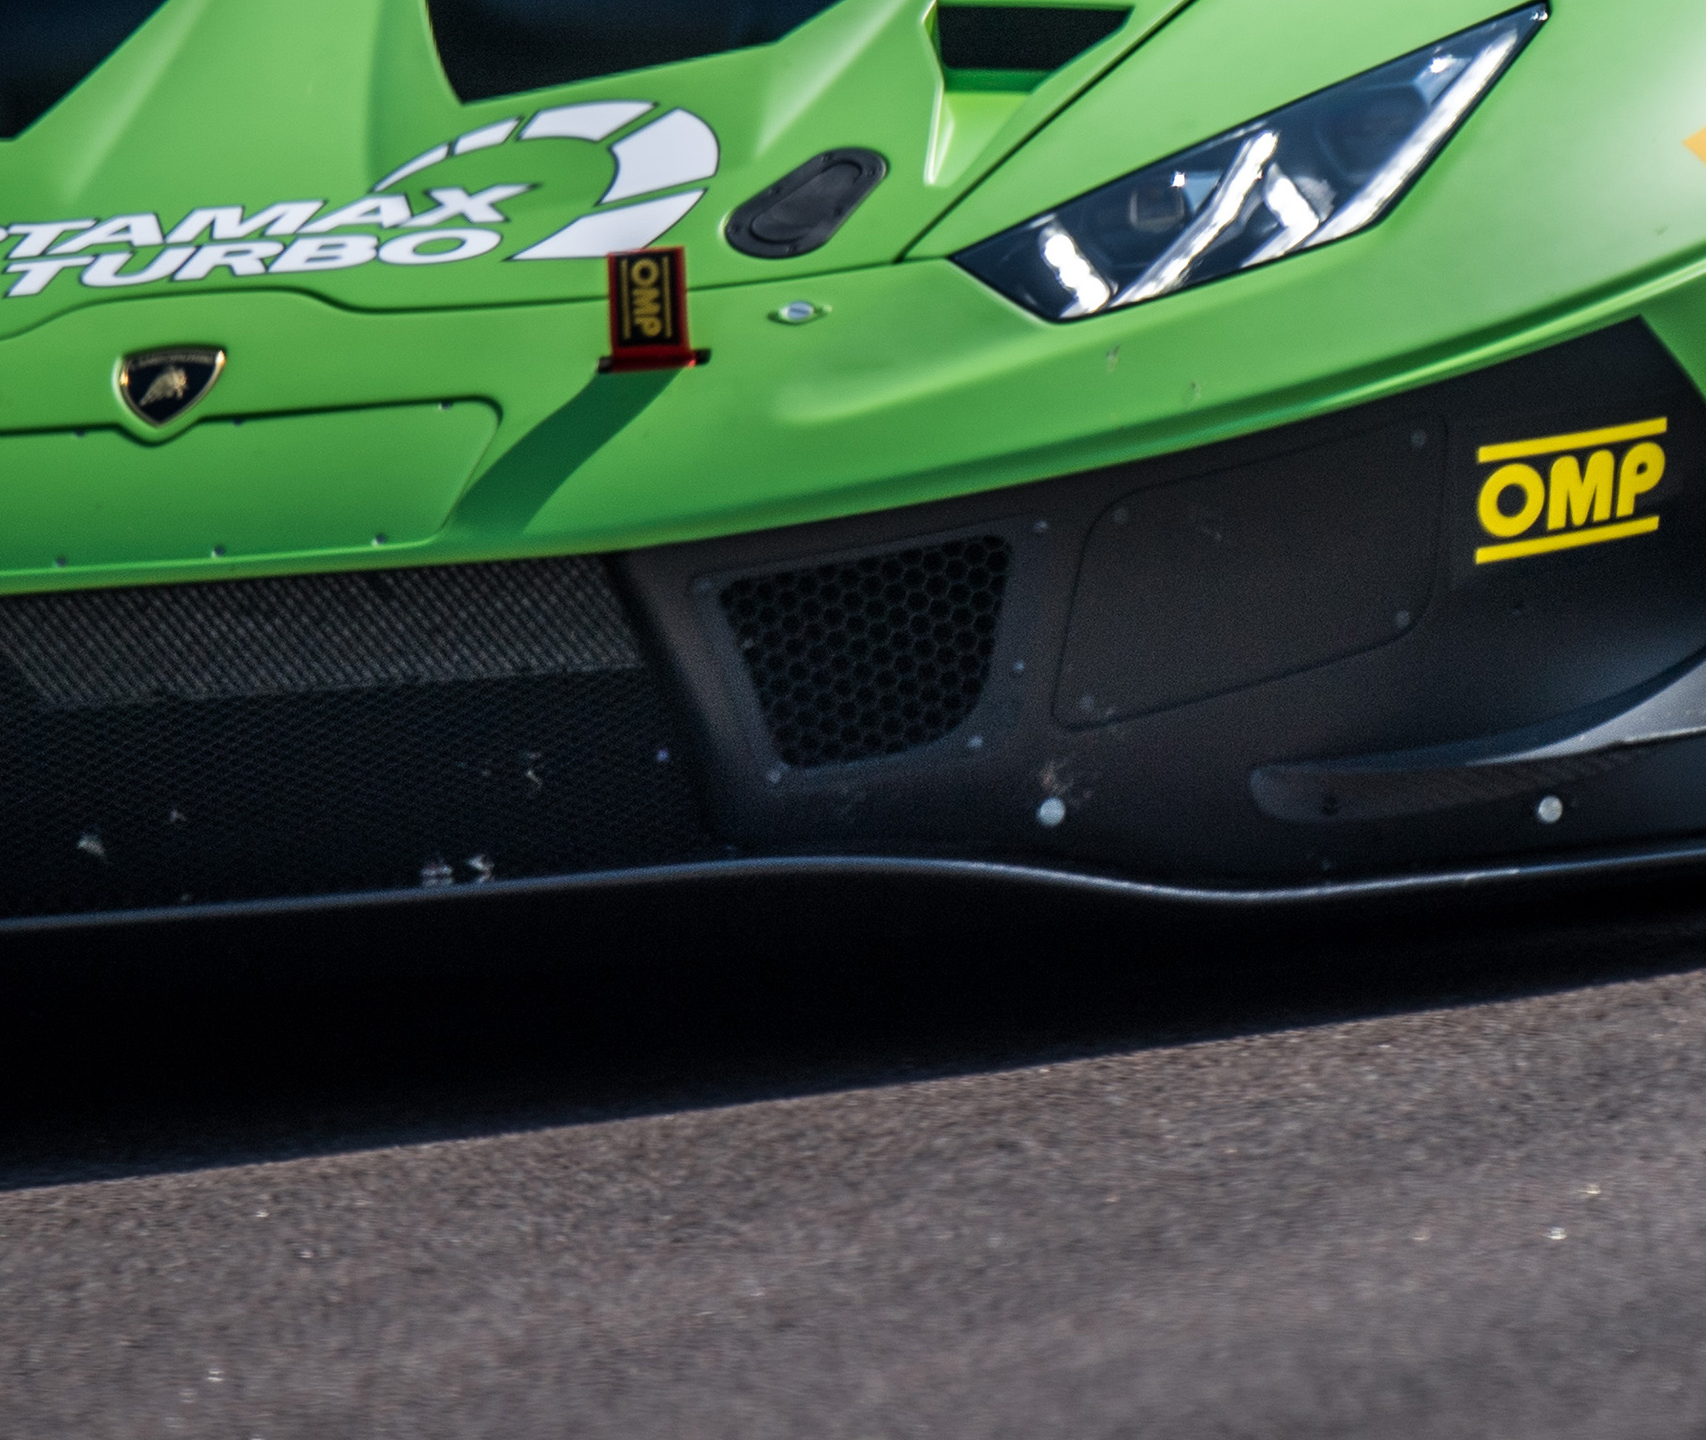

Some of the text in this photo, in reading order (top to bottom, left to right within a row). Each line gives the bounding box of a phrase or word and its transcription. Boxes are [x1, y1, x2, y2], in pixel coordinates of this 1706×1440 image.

[2, 227, 502, 298] TURBO
[631, 258, 662, 337] OMP
[1477, 441, 1666, 538] OMP
